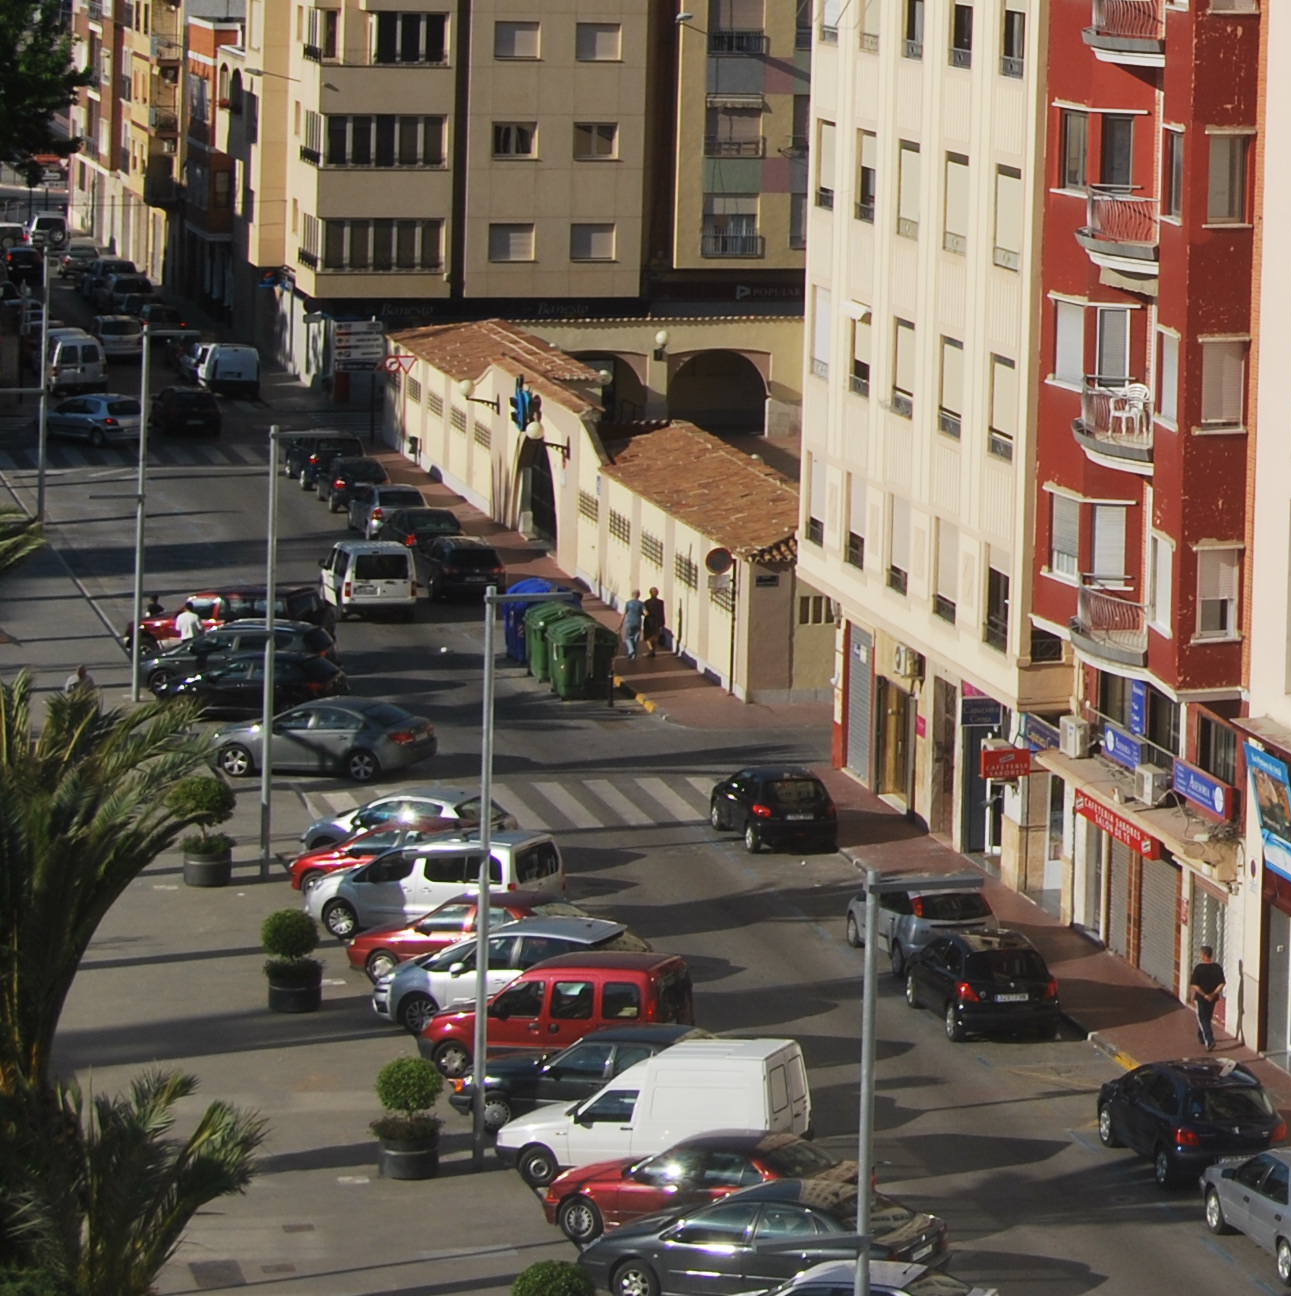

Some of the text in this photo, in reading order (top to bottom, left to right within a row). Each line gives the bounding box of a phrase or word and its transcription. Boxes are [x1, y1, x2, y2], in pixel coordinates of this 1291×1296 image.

[752, 287, 800, 297] POPULAR
[381, 303, 433, 316] Banesto
[538, 302, 589, 315] Banesto
[985, 763, 1028, 771] CAFETERIA
[1084, 797, 1114, 824] CAFETERIA
[1115, 817, 1141, 840] SABORES
[1114, 827, 1122, 839] DE
